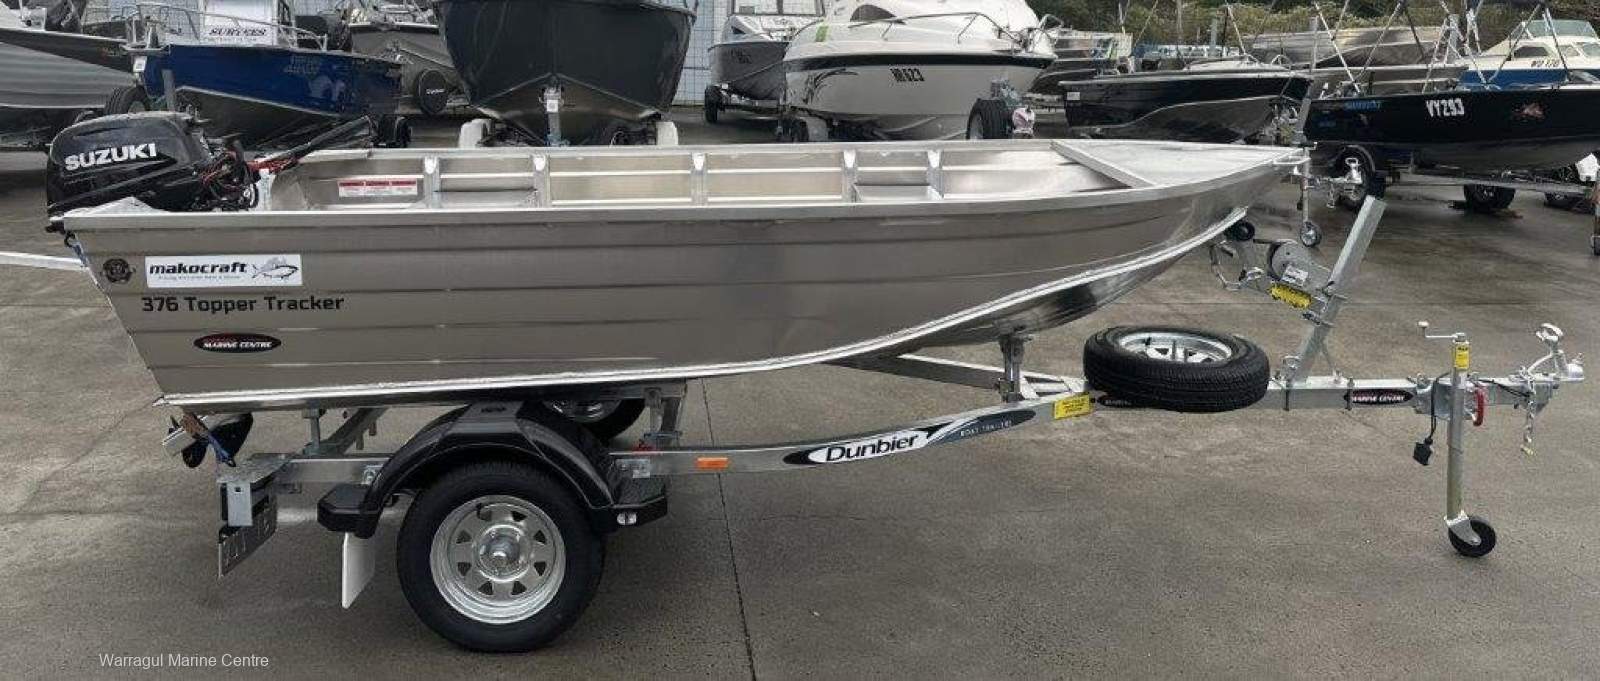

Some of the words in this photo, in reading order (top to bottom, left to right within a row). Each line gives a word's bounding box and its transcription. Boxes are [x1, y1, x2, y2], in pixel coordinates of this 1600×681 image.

[1425, 98, 1465, 117] VY293
[64, 142, 157, 171] SUZUKI
[149, 261, 247, 275] makocraft
[141, 297, 179, 312] 376
[183, 296, 257, 315] Topper
[263, 295, 345, 311] Tracker
[240, 341, 273, 349] CENTRE
[826, 434, 919, 462] Dunbier
